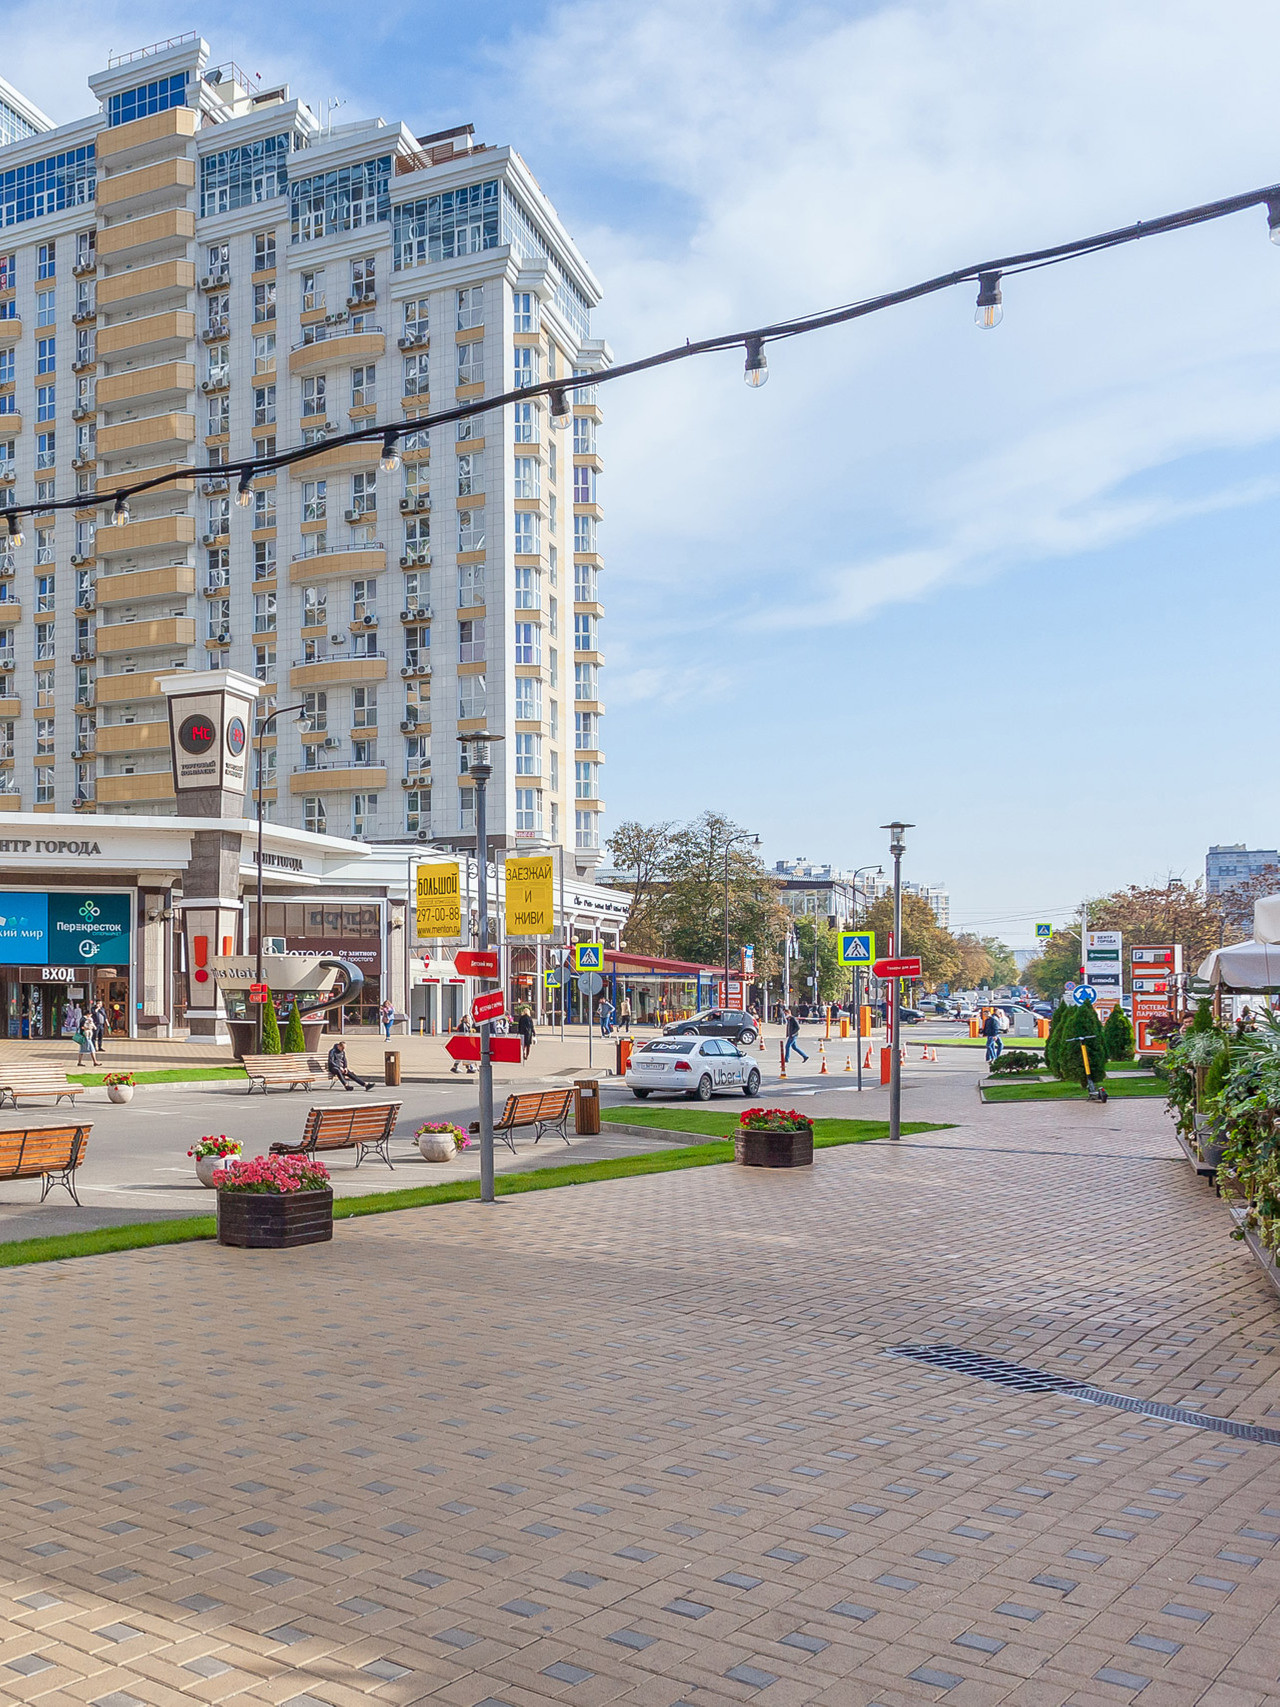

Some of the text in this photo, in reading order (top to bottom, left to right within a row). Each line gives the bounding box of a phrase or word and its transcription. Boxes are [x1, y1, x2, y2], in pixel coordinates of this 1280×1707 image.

[35, 840, 102, 856] ГОРОДА
[506, 864, 552, 882] ЗАЕЗЖАЙ
[418, 873, 457, 896] БОЛЬШОЙ
[524, 890, 532, 903] И
[417, 907, 460, 922] 297-00-88
[514, 911, 544, 925] ЖИВИ
[57, 921, 121, 933] Перекресток
[20, 929, 44, 940] мир
[42, 968, 76, 982] ВХОД
[651, 1042, 683, 1050] Uber
